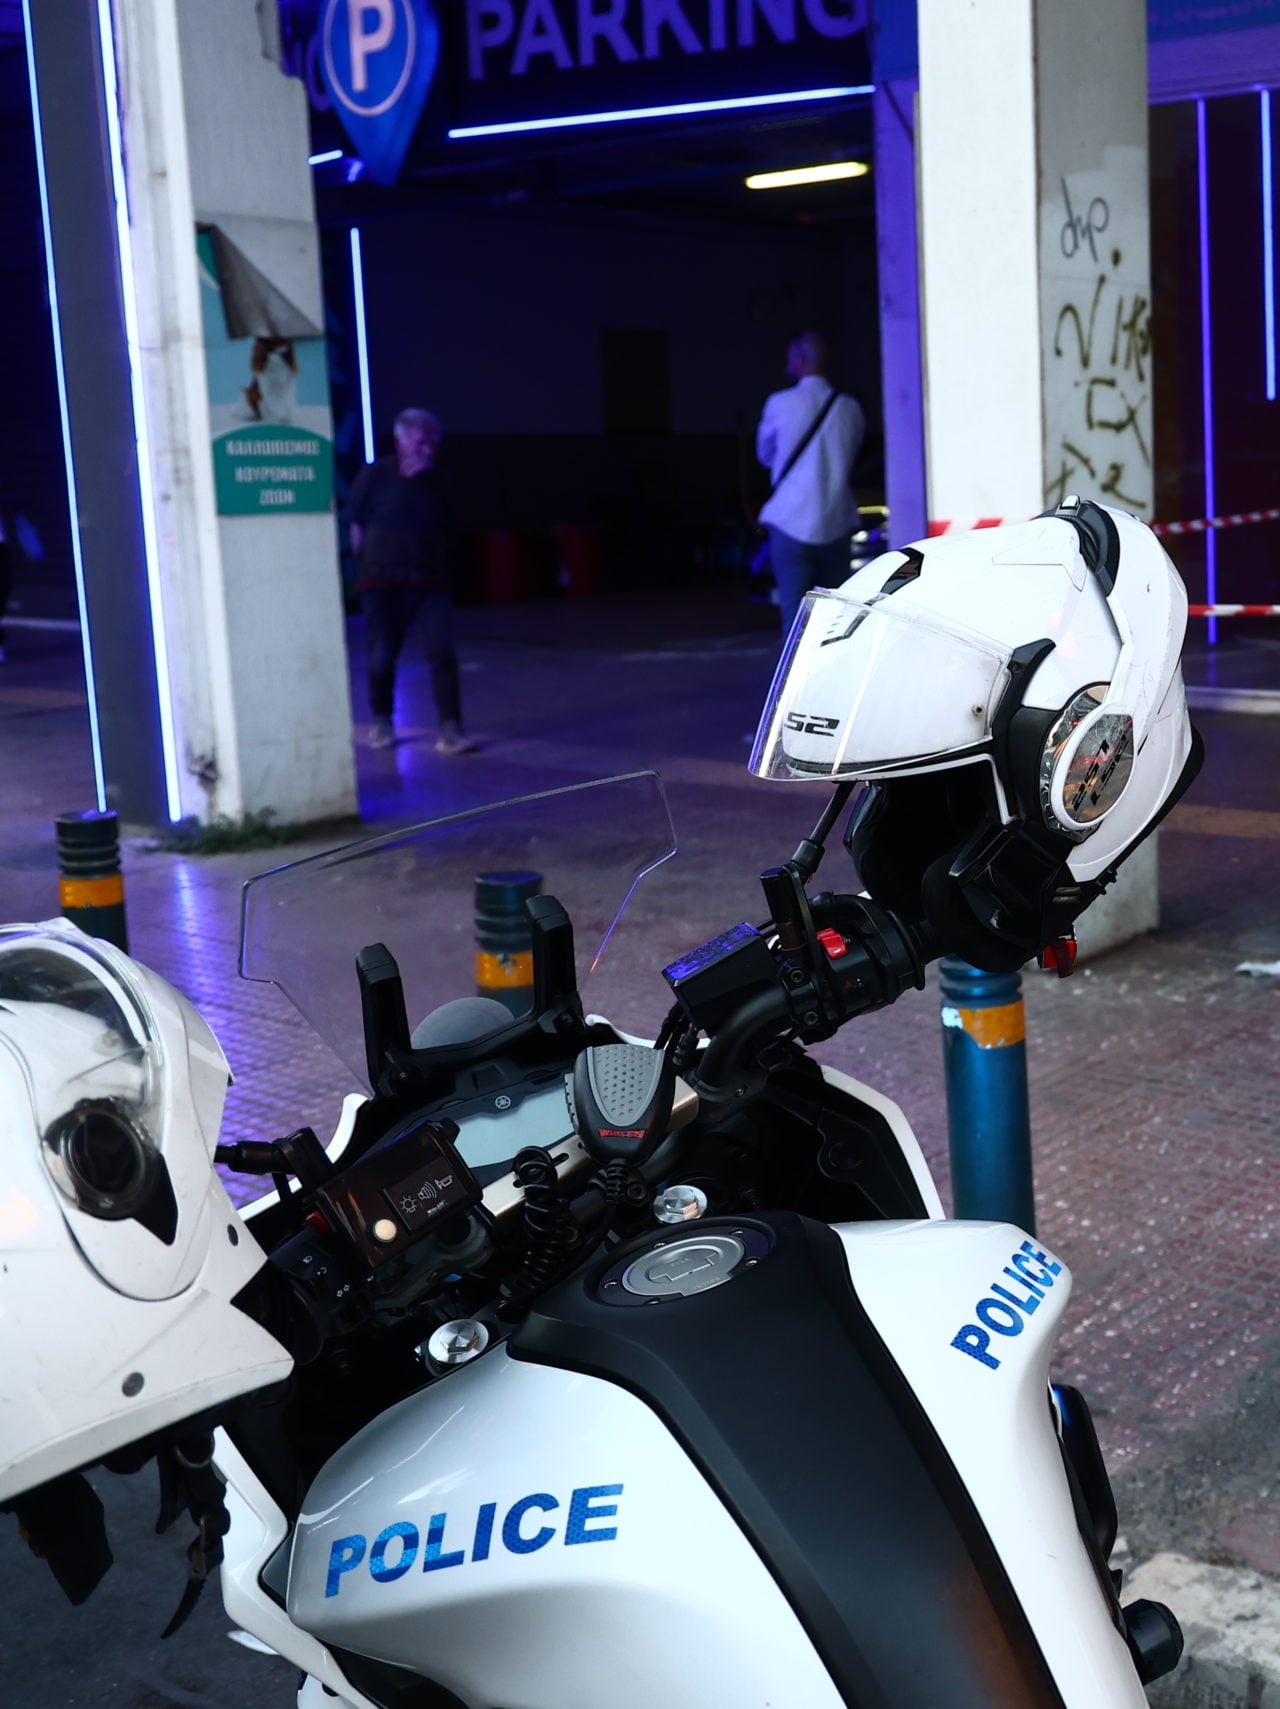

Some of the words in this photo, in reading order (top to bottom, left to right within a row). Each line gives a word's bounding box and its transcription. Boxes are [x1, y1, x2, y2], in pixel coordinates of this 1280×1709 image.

[347, 0, 396, 93] P
[466, 0, 869, 80] PARKING
[950, 1240, 1062, 1370] POLICE
[325, 1483, 625, 1598] POLICE
